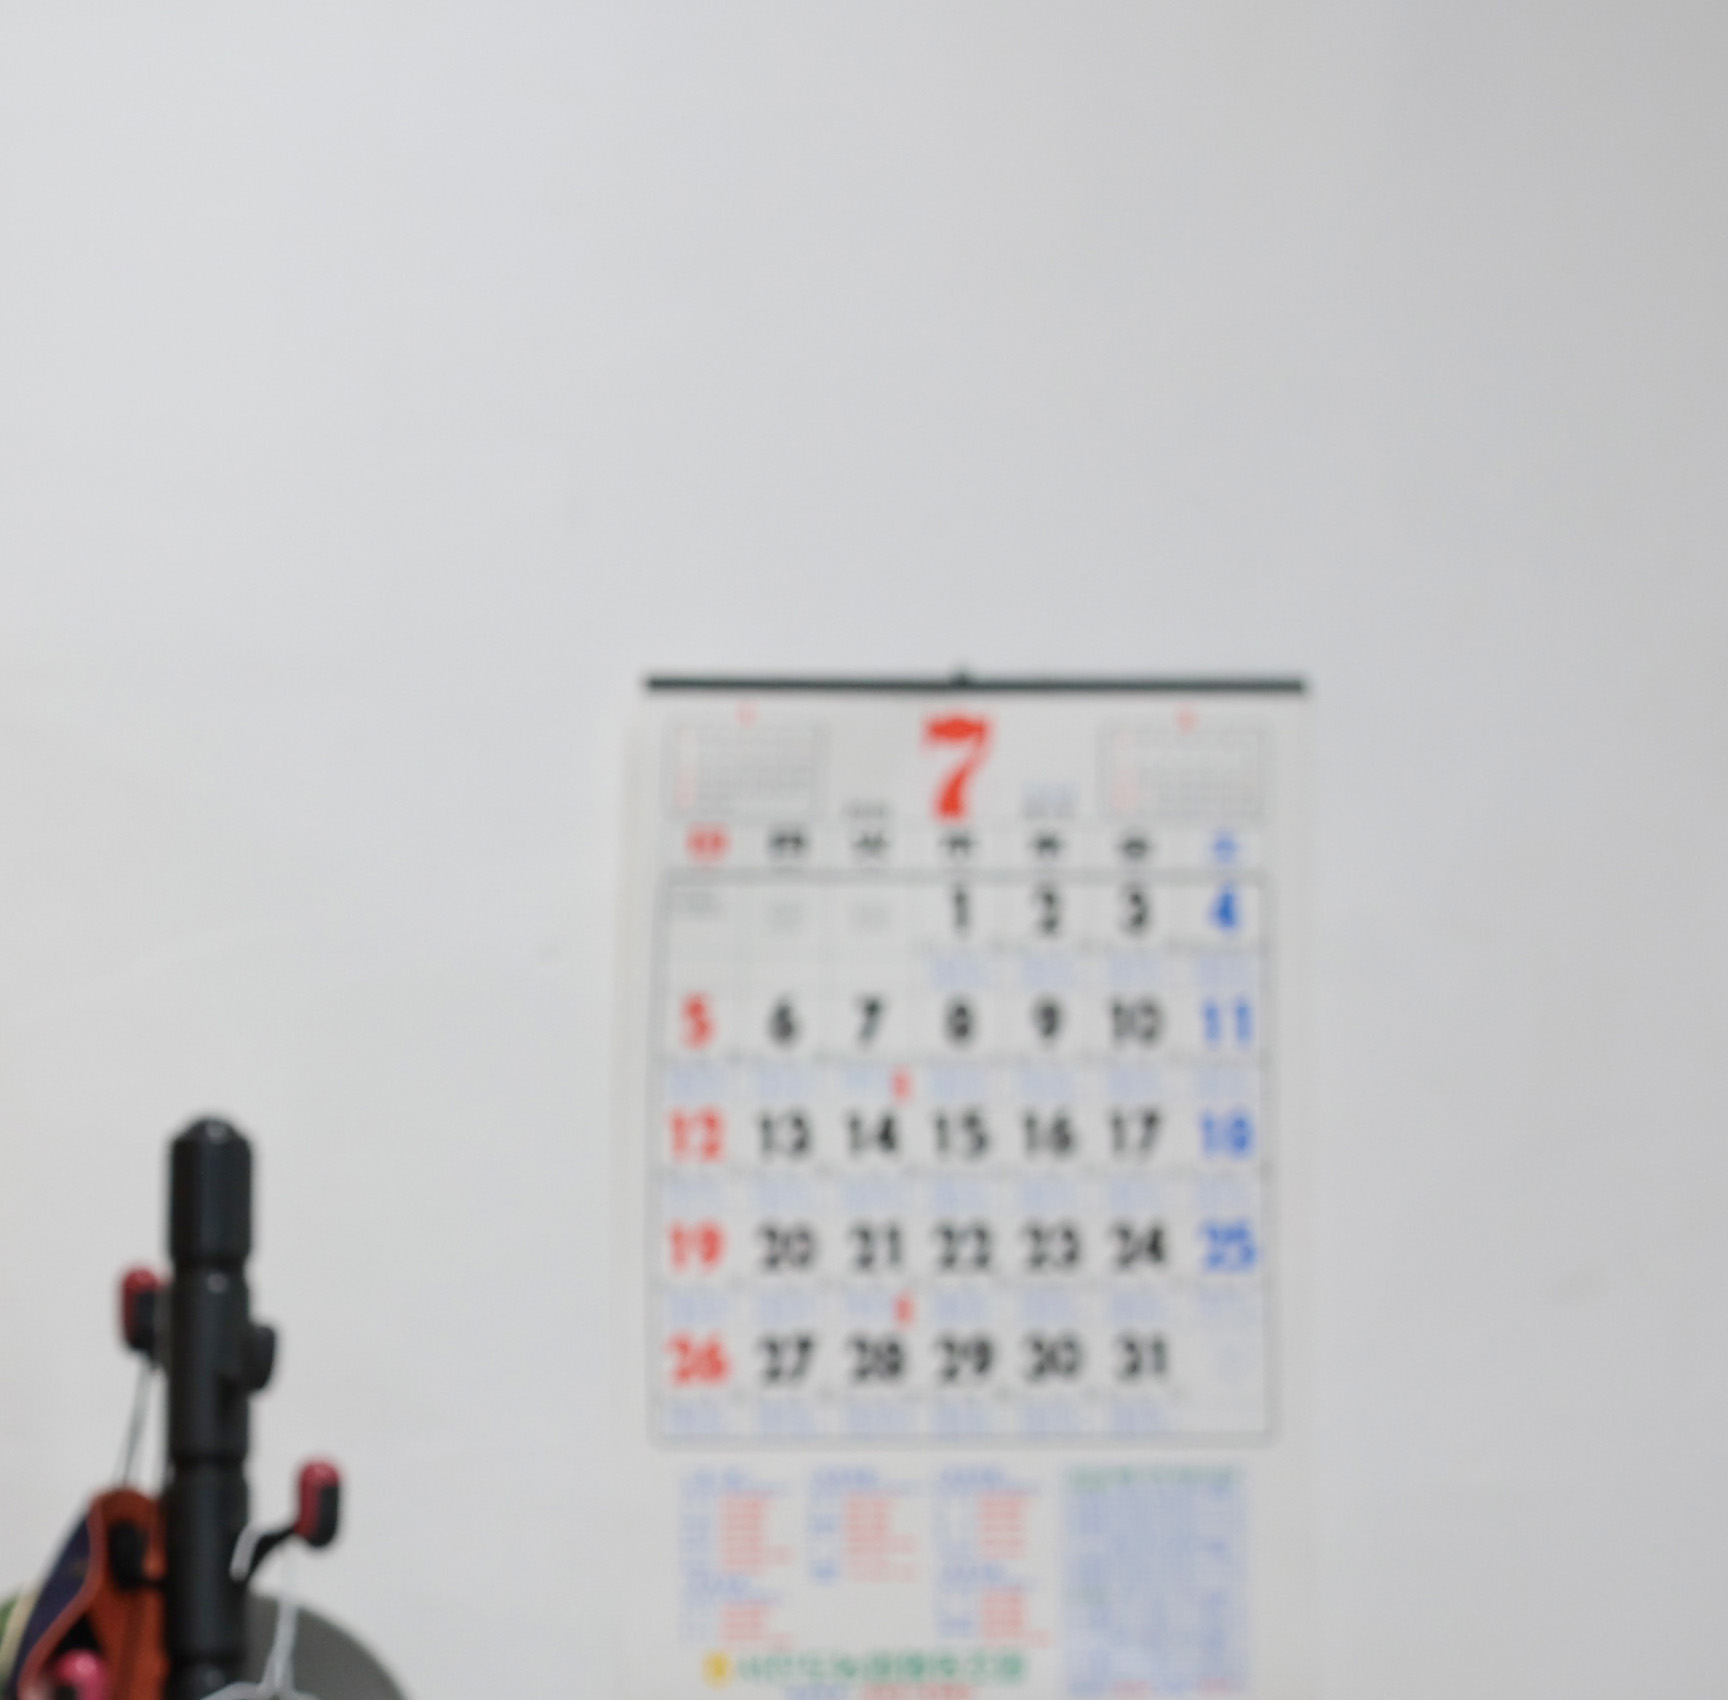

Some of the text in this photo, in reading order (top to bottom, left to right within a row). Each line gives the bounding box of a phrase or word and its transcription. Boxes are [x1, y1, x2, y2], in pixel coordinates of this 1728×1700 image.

[922, 712, 992, 823] 7
[949, 884, 973, 935] 1
[1206, 884, 1241, 932] 4
[681, 993, 715, 1048] 5
[767, 999, 801, 1046] 6
[853, 996, 888, 1046] 7
[1033, 998, 1064, 1045] 9
[1108, 997, 1165, 1047] 10
[1201, 998, 1254, 1043] 11
[669, 1108, 725, 1161] 12
[847, 1111, 901, 1156] 14
[932, 1108, 992, 1159] 15
[1021, 1112, 1079, 1158] 16
[1110, 1109, 1164, 1156] 17
[668, 1222, 726, 1268] 19
[848, 1222, 905, 1273] 21
[934, 1222, 994, 1272] 22
[1112, 1224, 1168, 1271] 24
[669, 1336, 731, 1385] 26
[760, 1333, 817, 1385] 27
[937, 1336, 997, 1384] 29
[1115, 1334, 1169, 1382] 31
